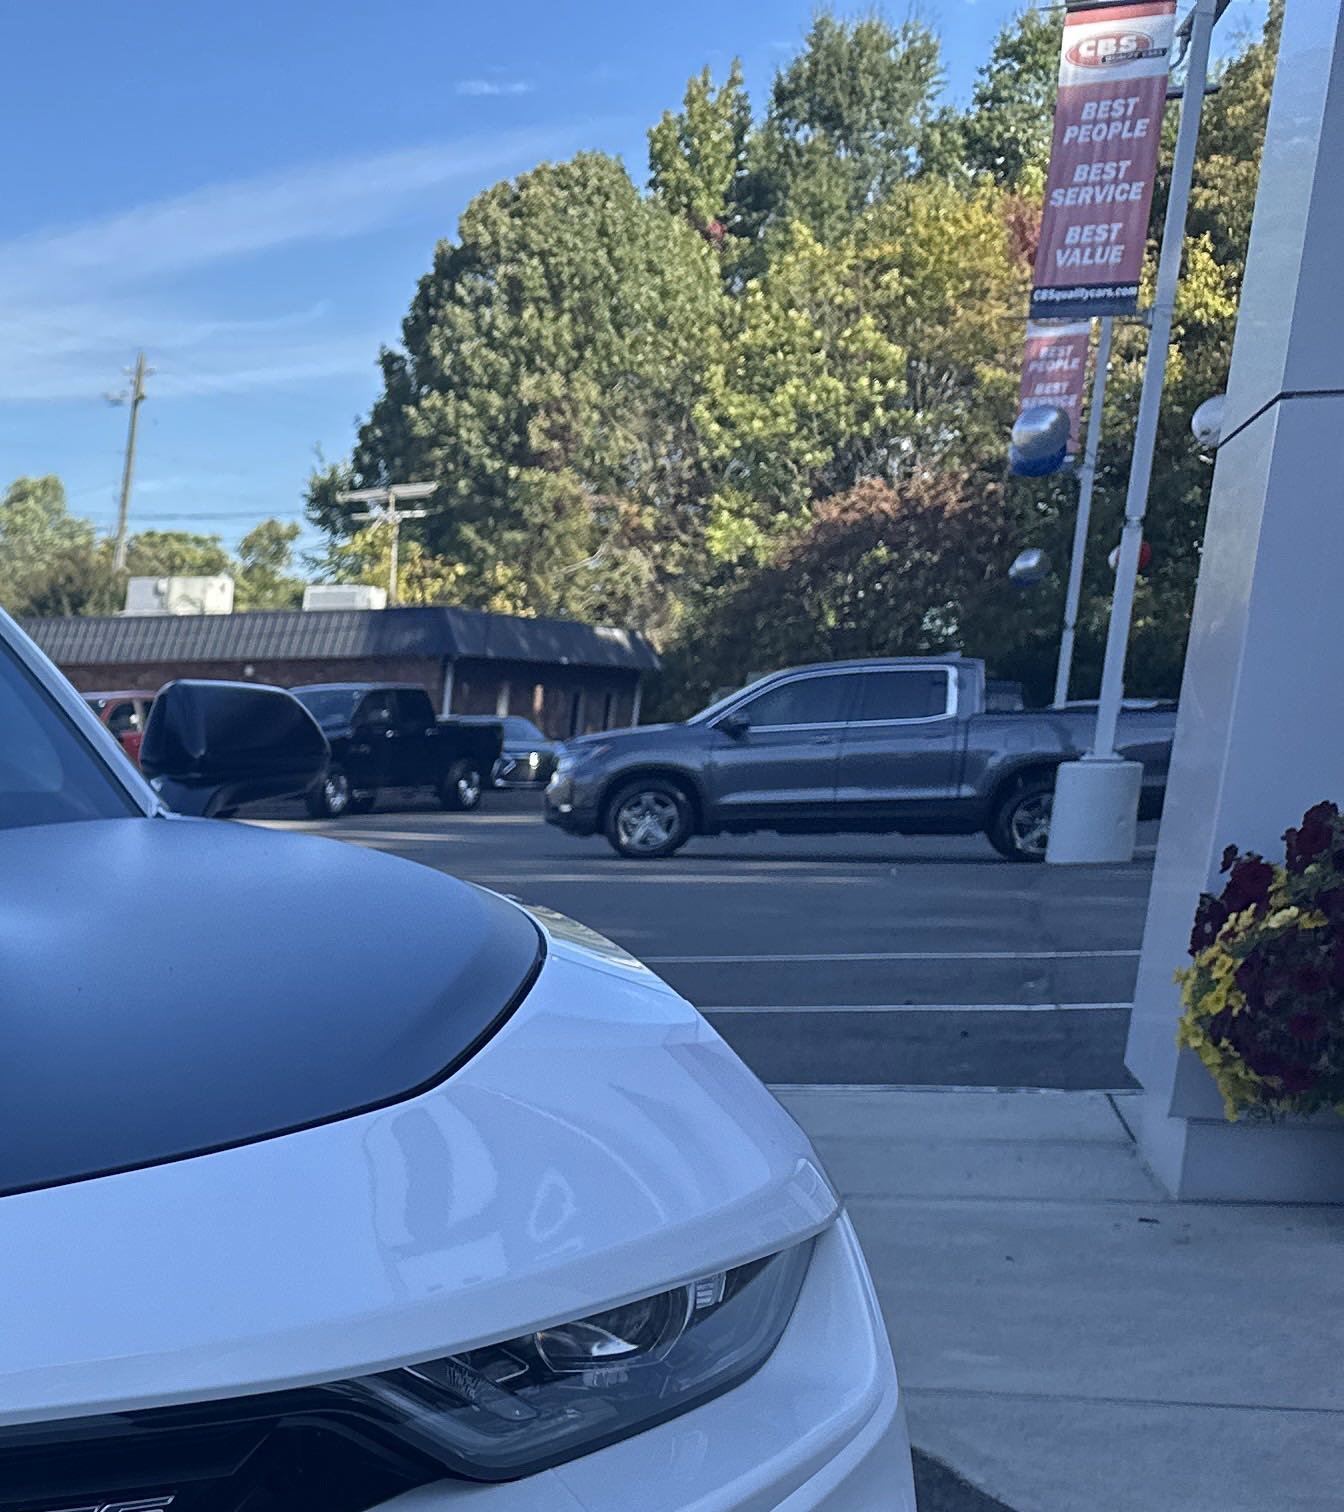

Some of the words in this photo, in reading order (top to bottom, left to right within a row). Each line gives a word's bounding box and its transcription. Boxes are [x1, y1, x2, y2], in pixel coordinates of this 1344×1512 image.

[1078, 35, 1138, 58] CBS
[1081, 97, 1140, 120] BEST
[1063, 118, 1150, 145] PEOPLE
[1073, 160, 1132, 182] BEST
[1050, 181, 1145, 207] SERVICE
[1064, 222, 1123, 245] BEST
[1056, 245, 1125, 268] VALUE
